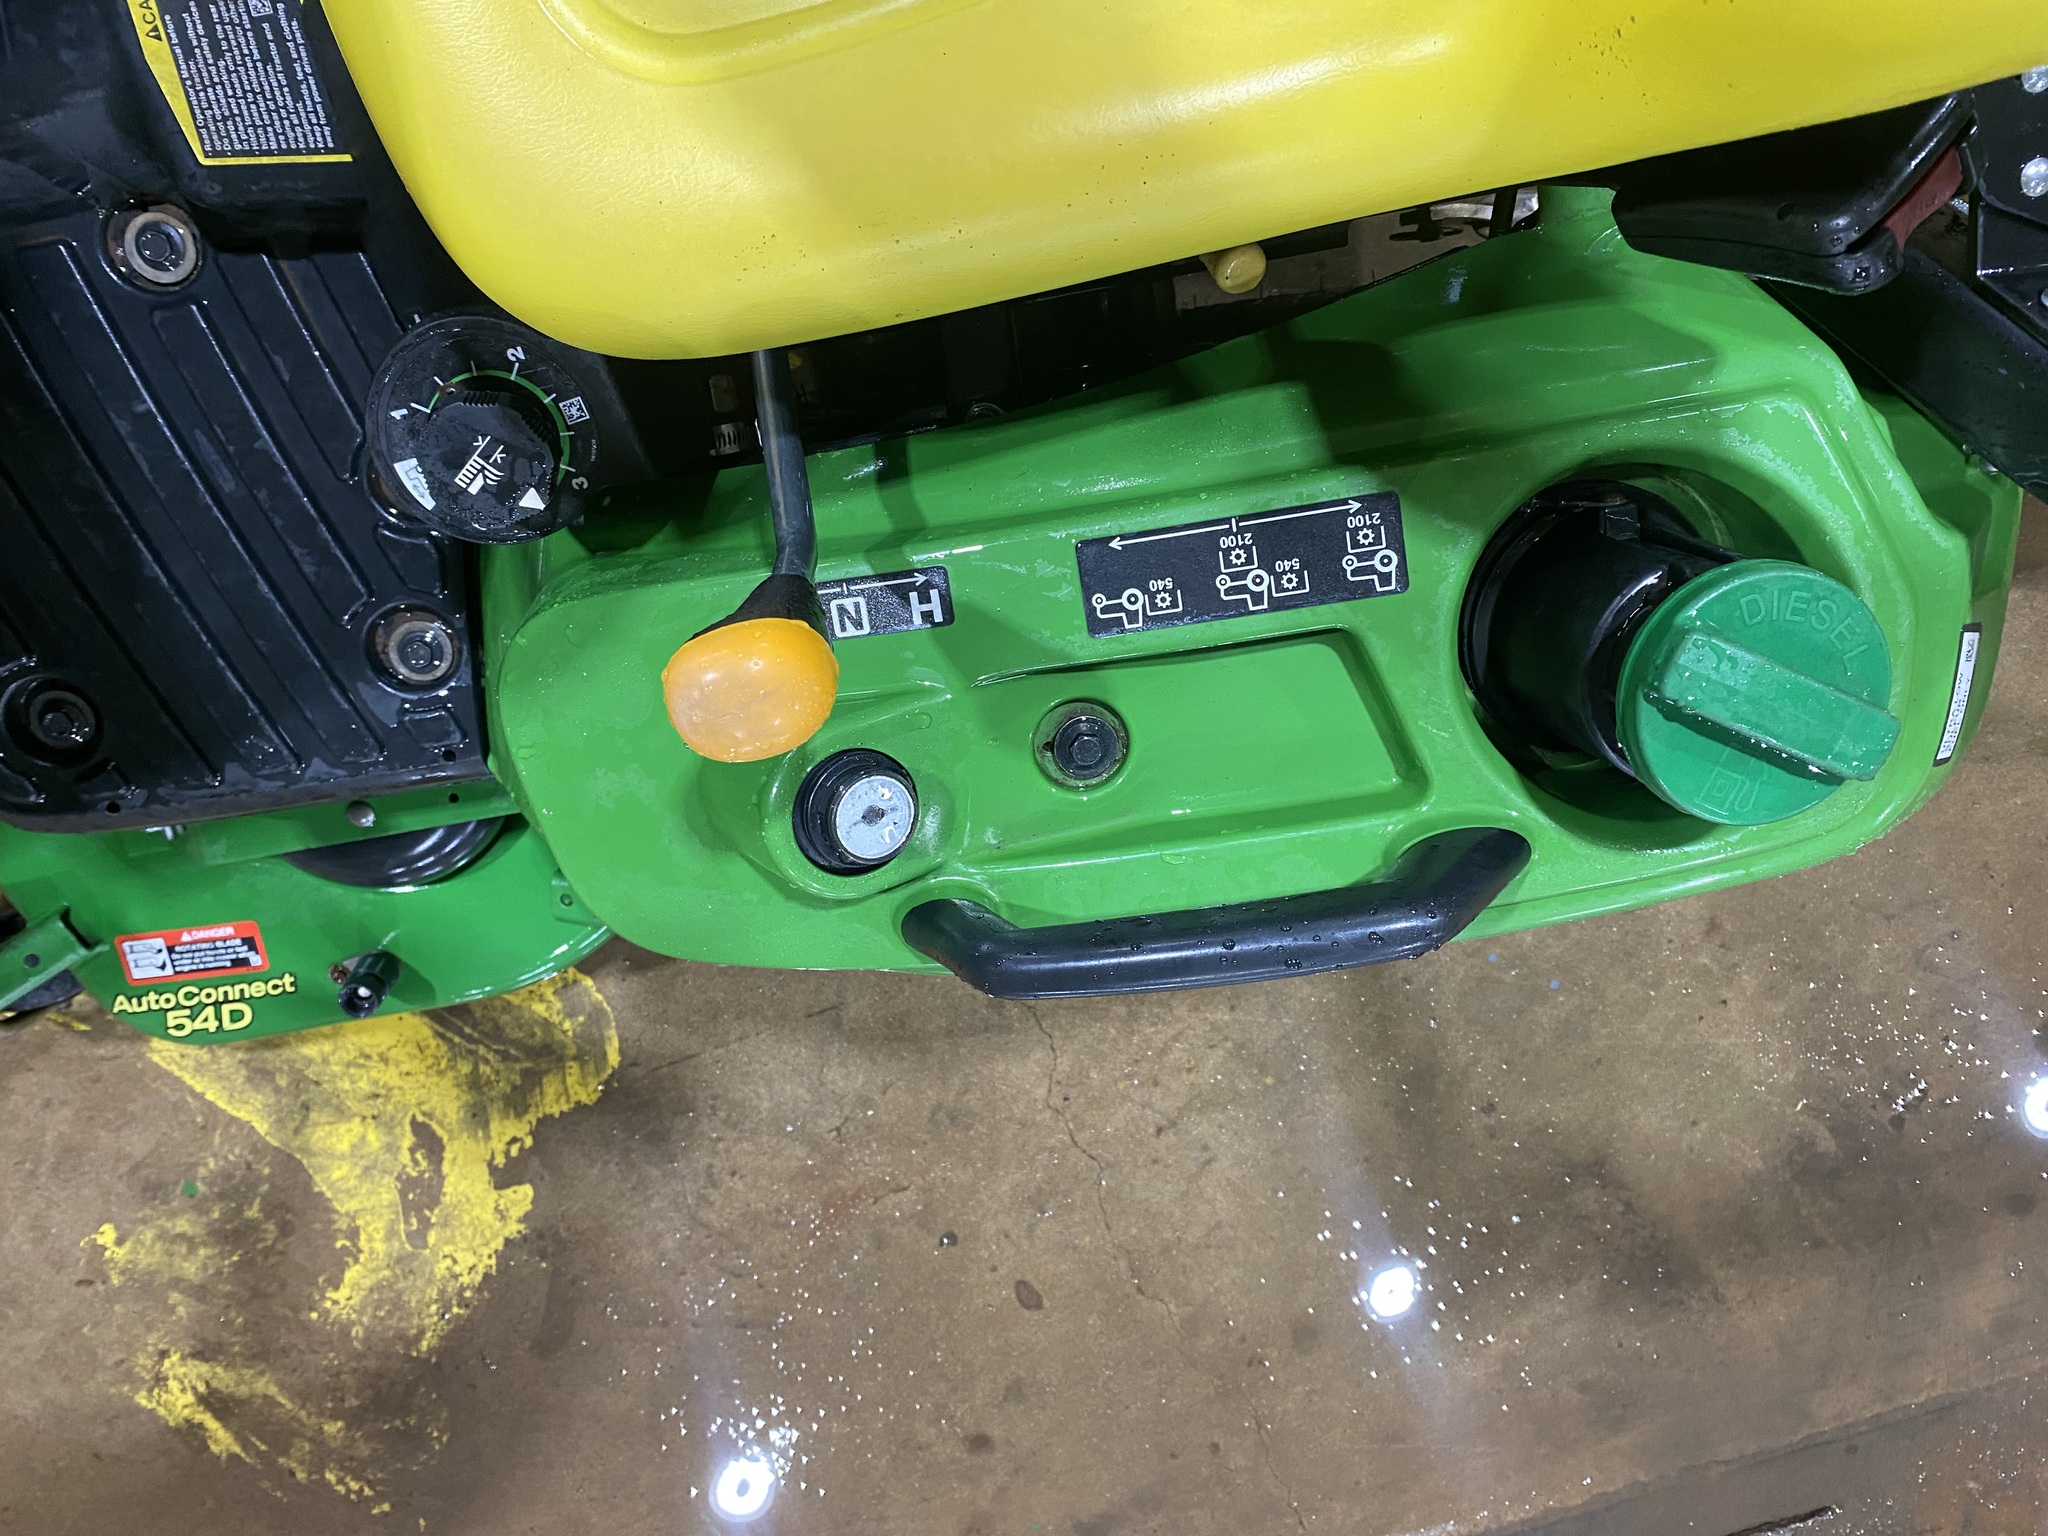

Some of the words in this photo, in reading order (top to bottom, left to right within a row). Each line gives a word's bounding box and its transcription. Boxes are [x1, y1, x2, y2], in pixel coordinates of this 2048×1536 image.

[189, 1, 204, 35] devices
[209, 4, 220, 22] rear
[217, 0, 229, 23] upse
[276, 3, 292, 40] clothing
[164, 15, 178, 44] before
[182, 13, 197, 46] without
[215, 24, 224, 39] the
[235, 26, 249, 54] and/or
[261, 23, 273, 40] and
[291, 18, 304, 44] parts.
[200, 38, 214, 64] safety
[221, 41, 228, 50] to
[224, 25, 242, 64] rearward
[246, 31, 260, 60] before
[286, 42, 297, 58] and
[172, 46, 189, 78] Manual
[194, 48, 210, 85] machine
[224, 52, 235, 71] only
[268, 42, 282, 71] tractor
[299, 46, 312, 74] driven
[188, 59, 202, 90] tractor.
[208, 66, 219, 83] and
[217, 58, 234, 96] working.
[236, 67, 250, 90] avoid
[245, 57, 260, 92] children
[256, 62, 272, 99] machine
[276, 73, 287, 85] off
[293, 60, 304, 80] feet,
[230, 73, 243, 97] loads
[266, 62, 284, 106] operation.
[307, 76, 322, 102] power
[185, 80, 204, 126] Operator's
[198, 91, 208, 108] this
[206, 88, 222, 120] operate
[215, 85, 229, 116] shields
[227, 98, 239, 114] and
[246, 93, 253, 102] to
[266, 101, 275, 110] of
[282, 87, 295, 112] riders
[300, 81, 314, 111] hands,
[237, 99, 251, 125] towed
[250, 104, 263, 125] plate
[256, 95, 270, 125] certain
[279, 109, 287, 118] or
[289, 114, 298, 124] all
[308, 113, 317, 124] all
[316, 104, 327, 124] from
[203, 110, 222, 151] operating
[216, 122, 226, 136] not
[235, 117, 248, 139] place
[271, 112, 282, 133] clear
[296, 100, 315, 148] equipment.
[199, 129, 212, 151] Read
[223, 138, 231, 150] Do
[226, 118, 242, 150] guards,
[247, 127, 259, 150] Hitch
[257, 128, 268, 150] hitch
[266, 127, 278, 149] Make
[278, 135, 287, 149] are
[283, 120, 297, 149] engine
[294, 127, 306, 148] Keep
[313, 126, 325, 148] Keep
[322, 126, 334, 148] away
[241, 142, 249, 150] in
[507, 346, 526, 362] 2
[390, 408, 408, 420] 1
[571, 476, 589, 491] 3
[1347, 512, 1381, 529] 2100
[1219, 533, 1253, 549] 2100
[1275, 558, 1300, 573] 540
[1149, 577, 1173, 592] 540
[835, 601, 865, 633] N
[908, 588, 944, 625] H
[1739, 590, 1869, 675] DIESEL
[190, 926, 235, 940] DANGER
[215, 938, 242, 947] BLADE
[112, 972, 296, 1014] AutoConnect
[166, 1002, 253, 1037] 54D
